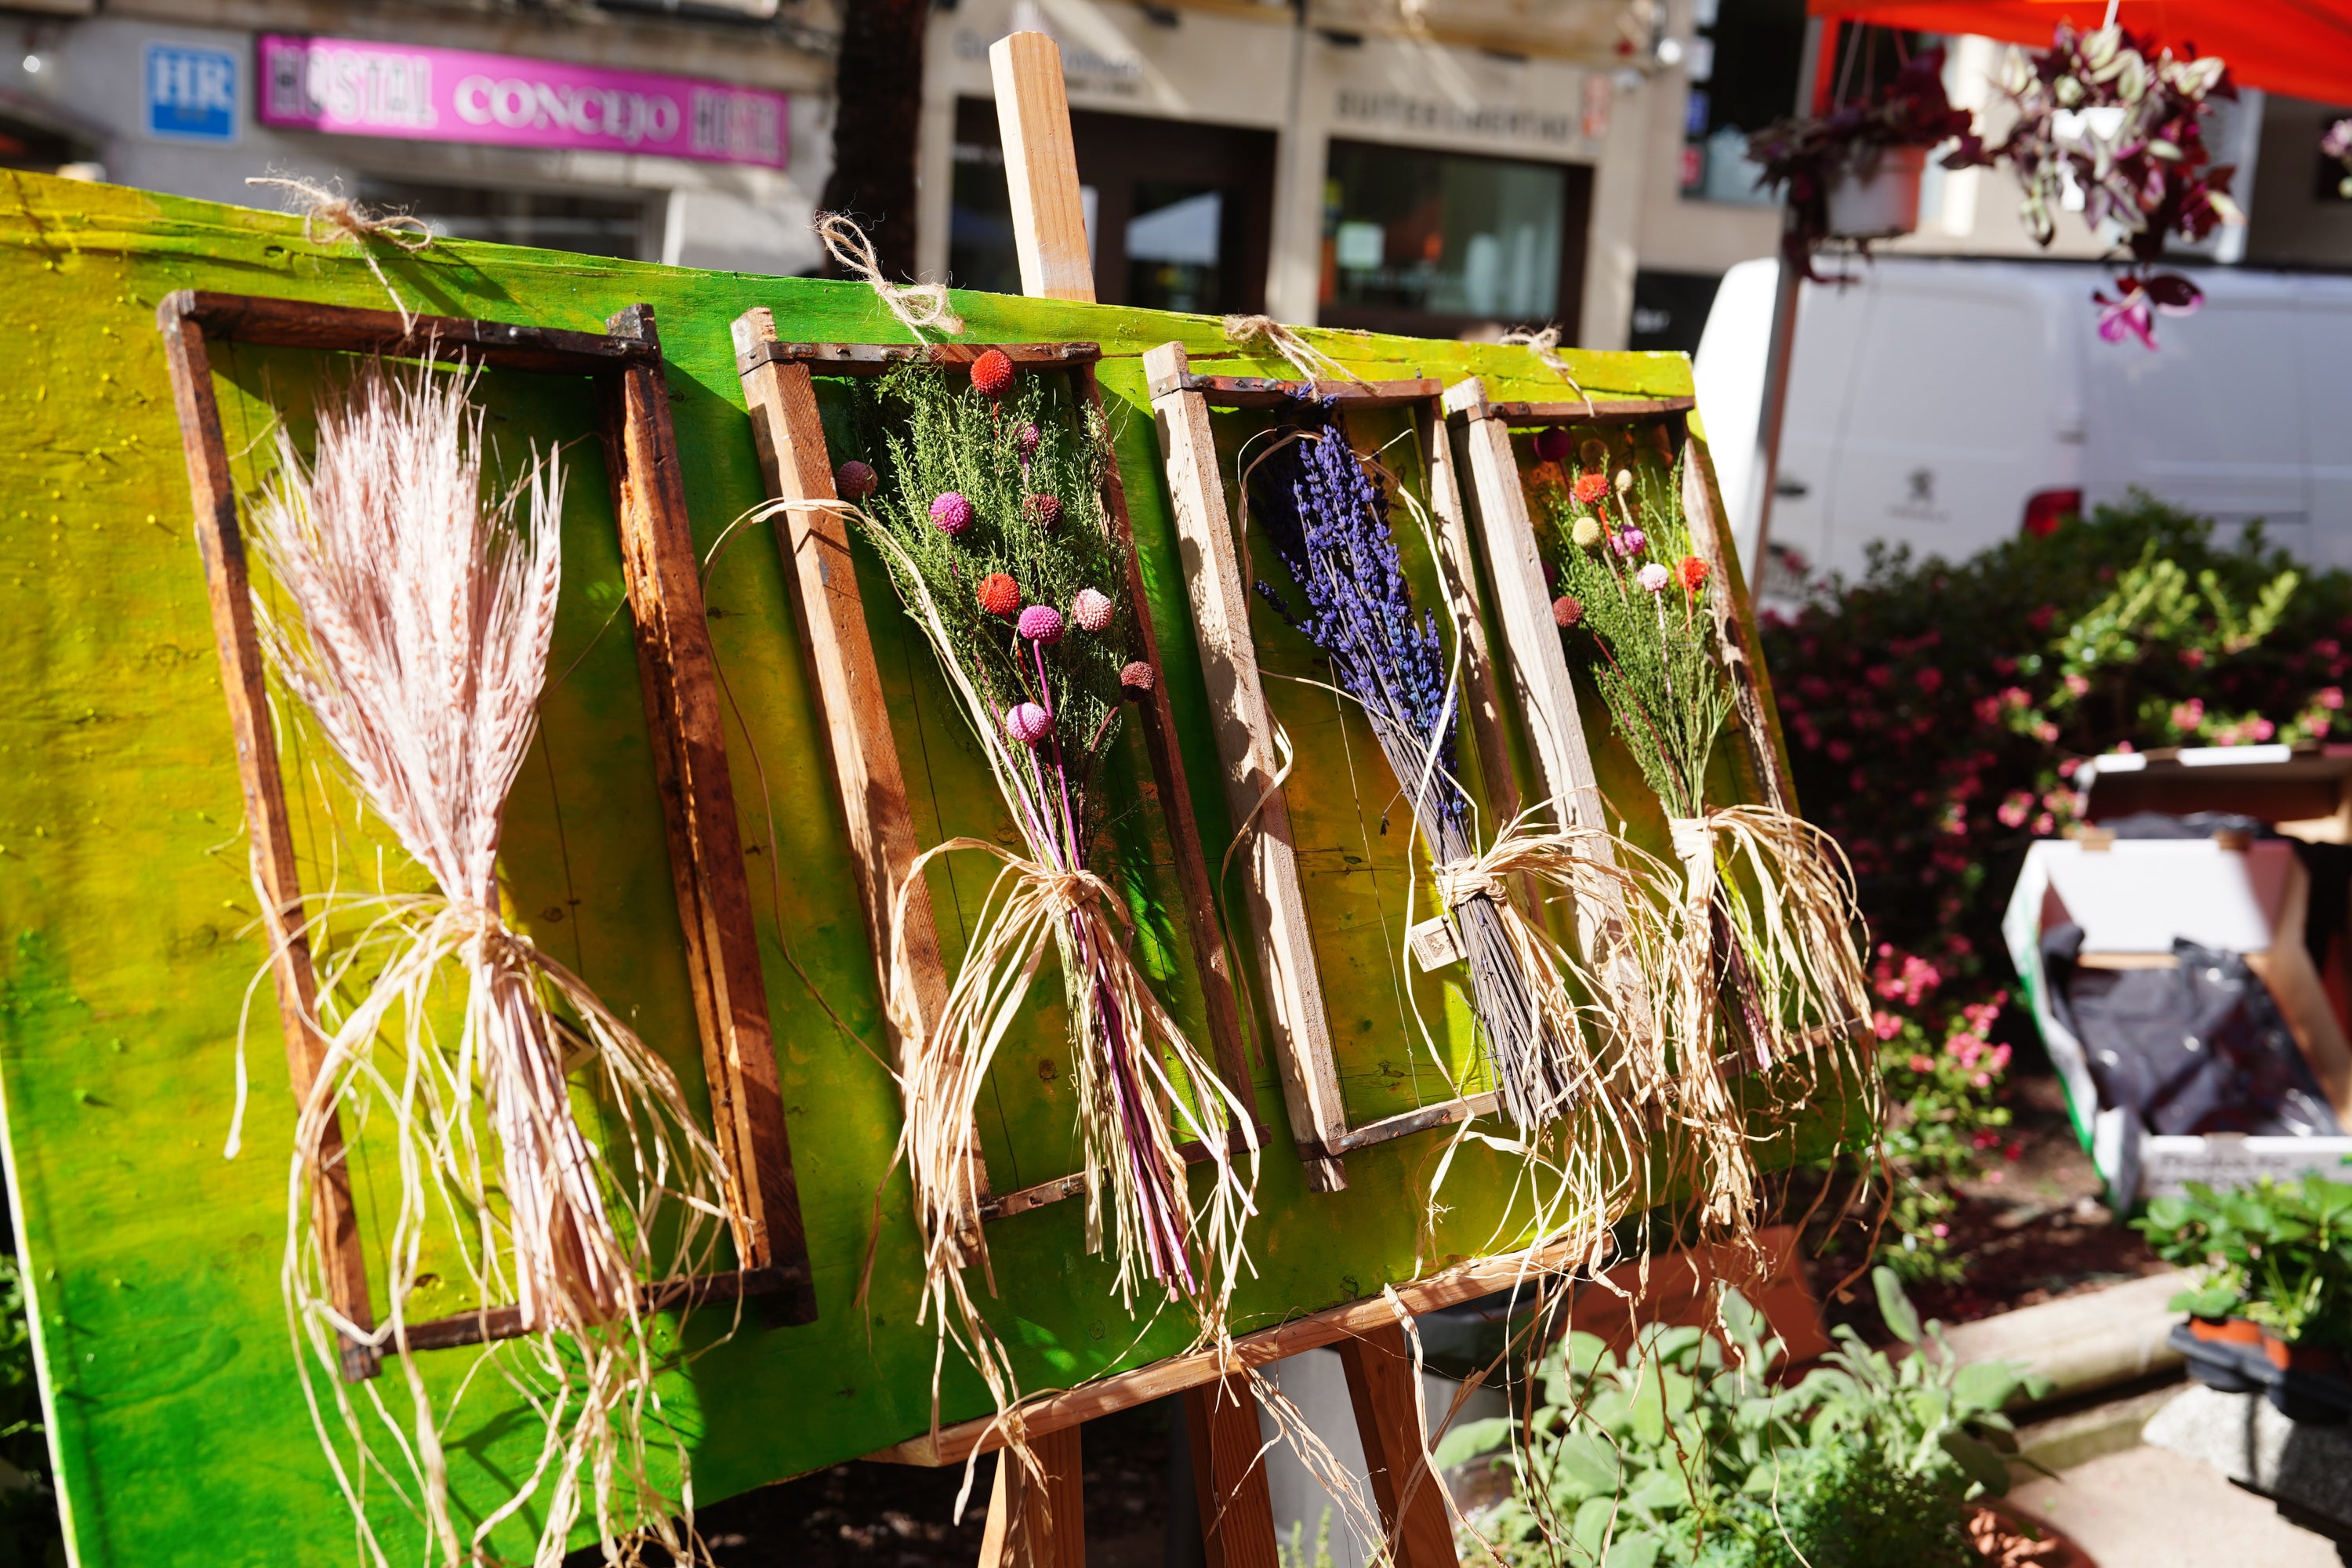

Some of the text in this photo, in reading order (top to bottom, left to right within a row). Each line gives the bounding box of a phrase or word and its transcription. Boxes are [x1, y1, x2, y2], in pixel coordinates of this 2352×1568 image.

[154, 53, 233, 111] HR
[268, 45, 439, 129] HOSTAL
[453, 74, 680, 147] CONCEJO
